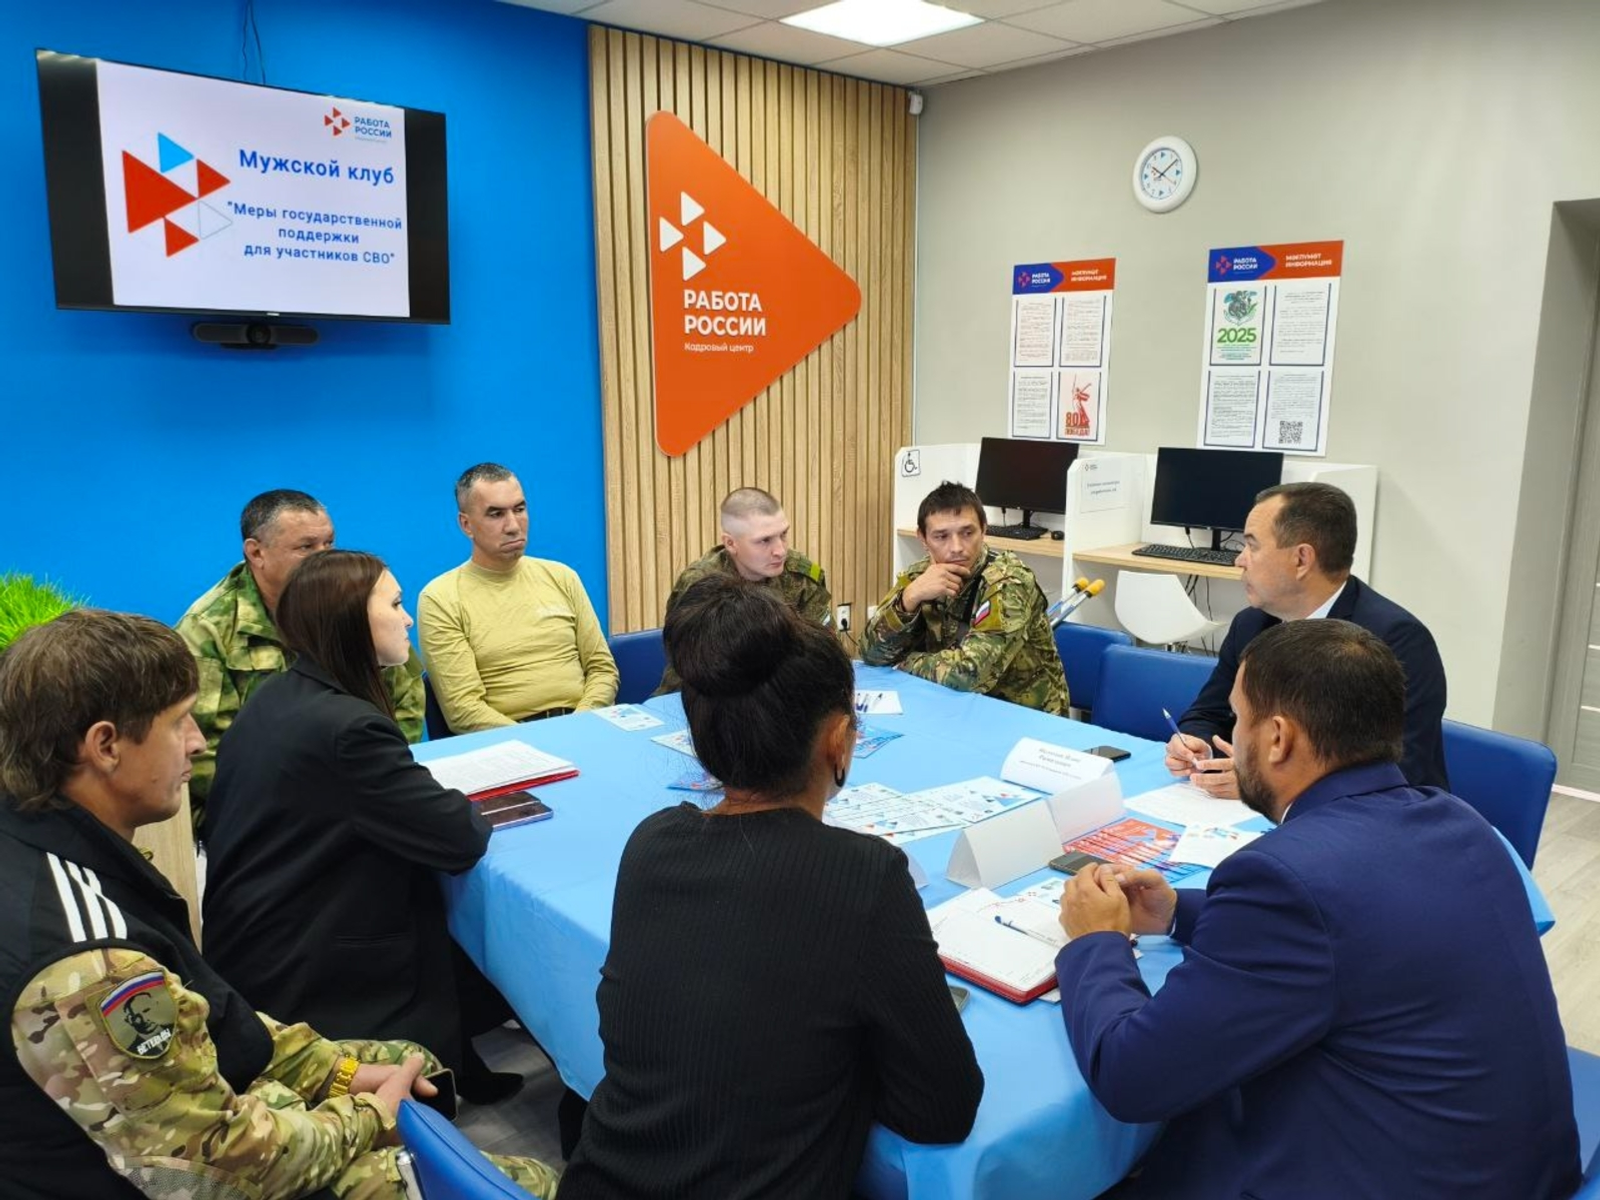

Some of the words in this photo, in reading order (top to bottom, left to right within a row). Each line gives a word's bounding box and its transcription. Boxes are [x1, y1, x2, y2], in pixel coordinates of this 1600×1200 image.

[354, 116, 390, 129] РАБОТА
[354, 125, 392, 138] РОССИИ
[239, 149, 340, 178] Мужской
[348, 166, 394, 186] клуб
[227, 201, 277, 219] "Меры
[282, 208, 402, 230] государственной
[278, 227, 360, 244] поддержки
[244, 245, 272, 257] для
[276, 247, 358, 262] участников
[363, 251, 395, 264] СВО"
[1233, 257, 1257, 265] РАБОТА
[1232, 263, 1258, 271] РОССИИ
[683, 289, 762, 312] РАБОТА
[684, 314, 766, 336] РОССИИ
[1217, 327, 1257, 343] 2025
[684, 342, 728, 353] Кадровый
[729, 343, 754, 354] центр
[1065, 411, 1079, 428] 80
